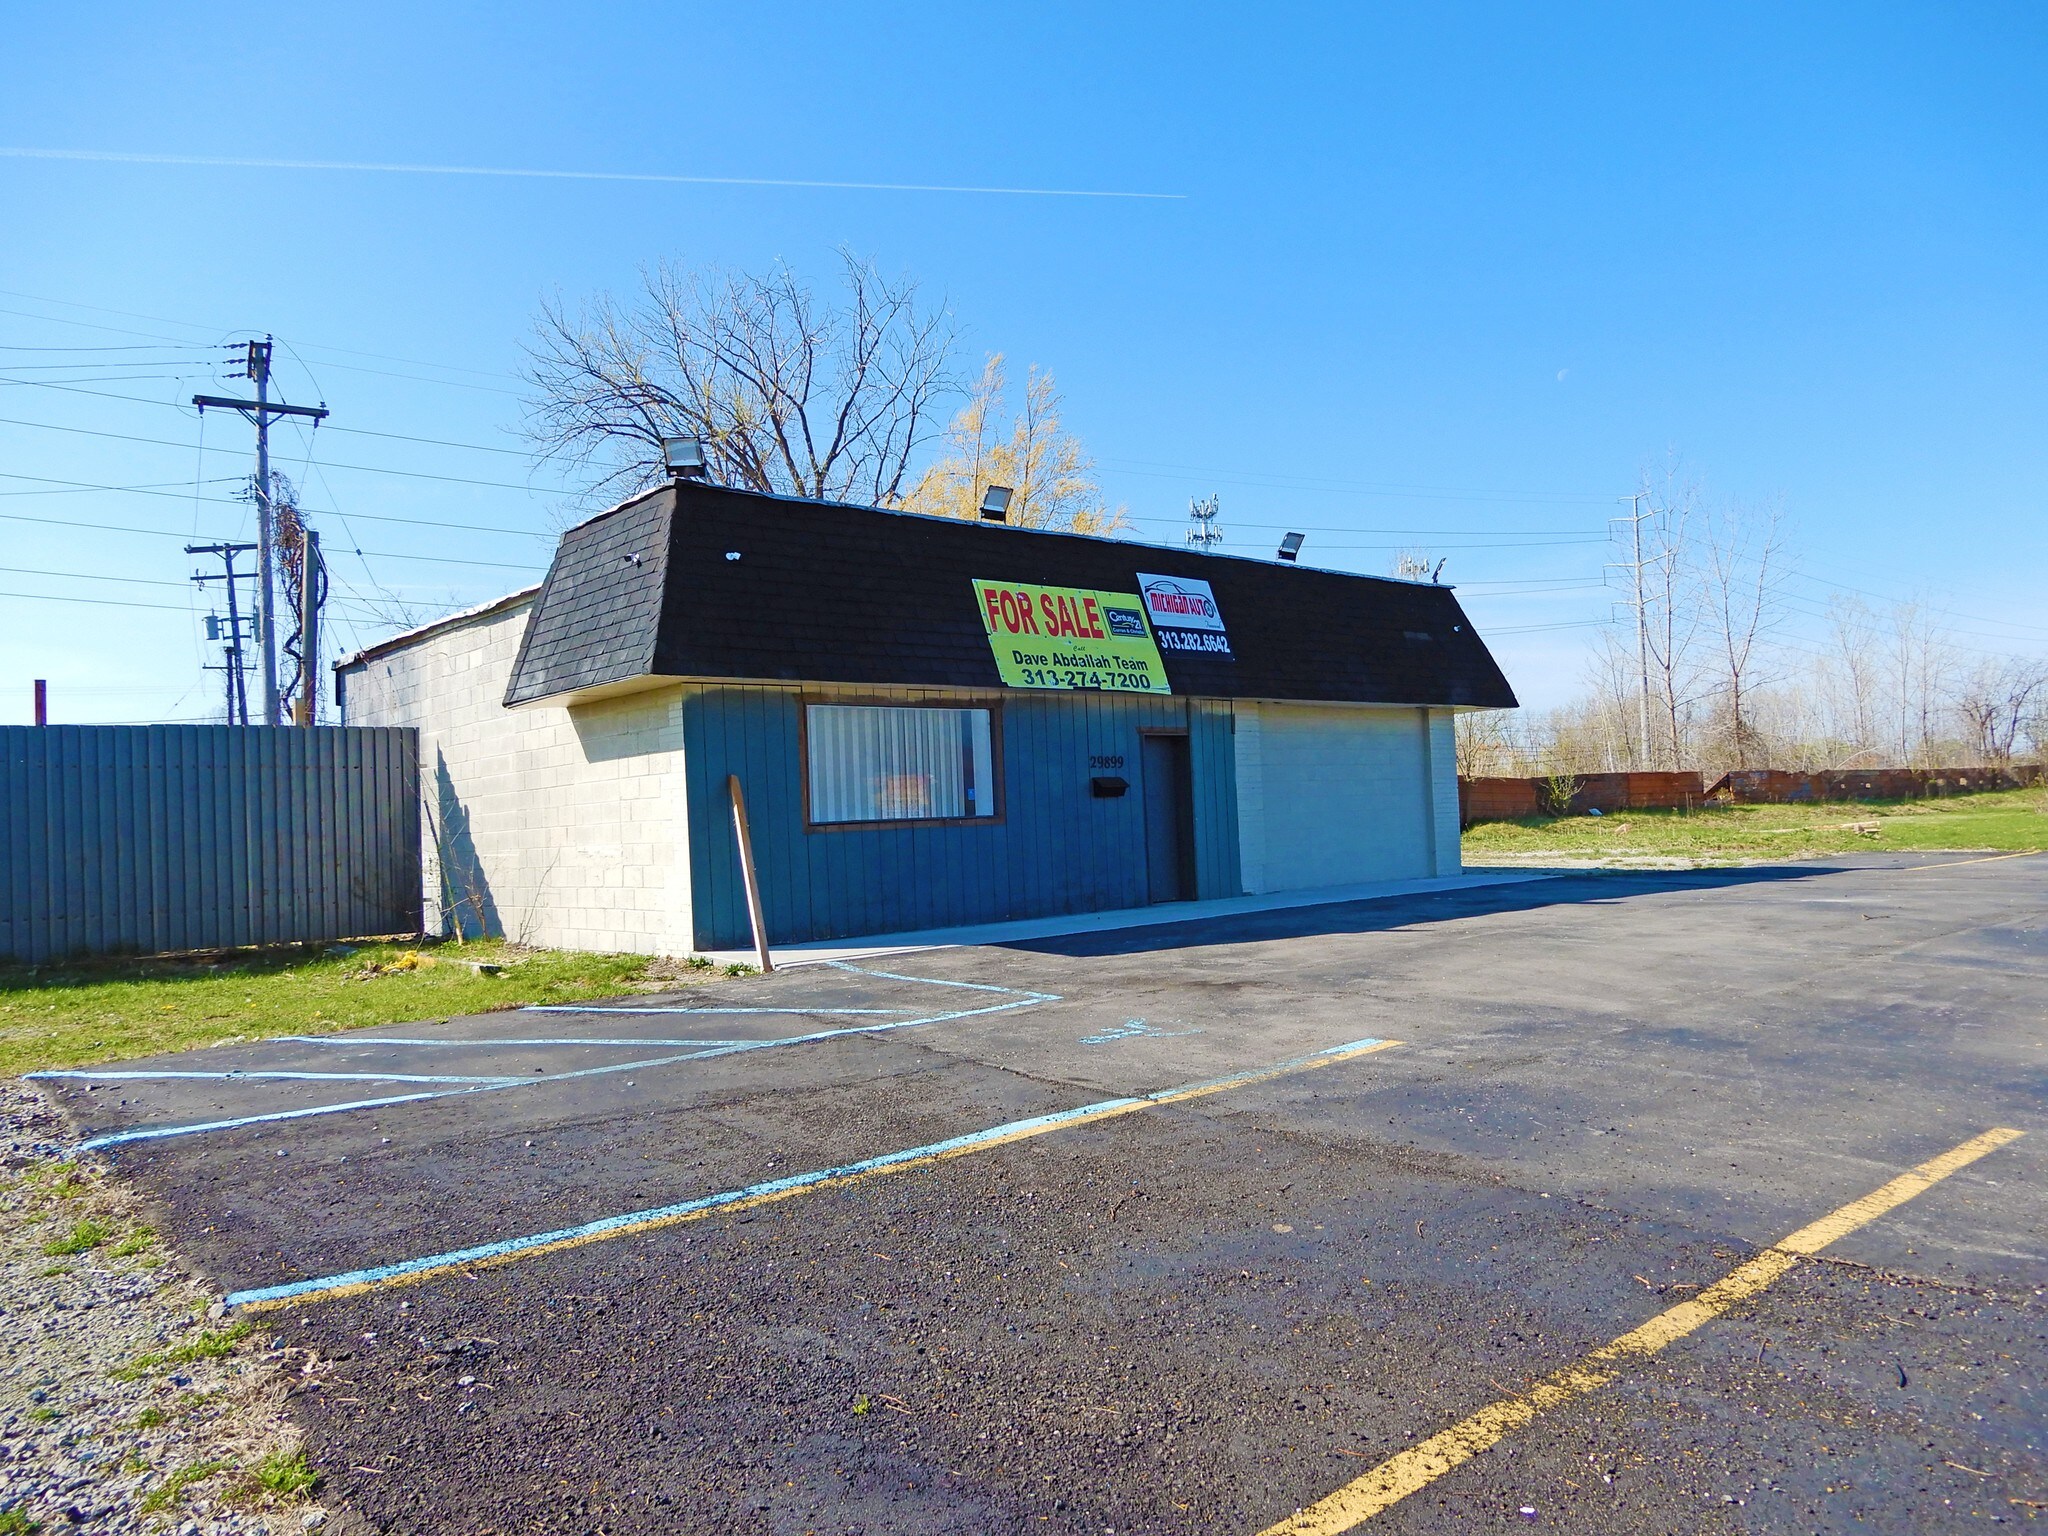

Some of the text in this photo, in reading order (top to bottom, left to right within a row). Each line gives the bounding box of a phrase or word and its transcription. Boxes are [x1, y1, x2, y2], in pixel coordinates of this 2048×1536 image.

[984, 588, 1105, 640] FOR SALE
[1158, 631, 1231, 653] 313.282.6642
[1012, 649, 1149, 671] Dave Abdallah Team
[1023, 668, 1151, 689] 313-274-7200
[1090, 755, 1124, 769] 29899
